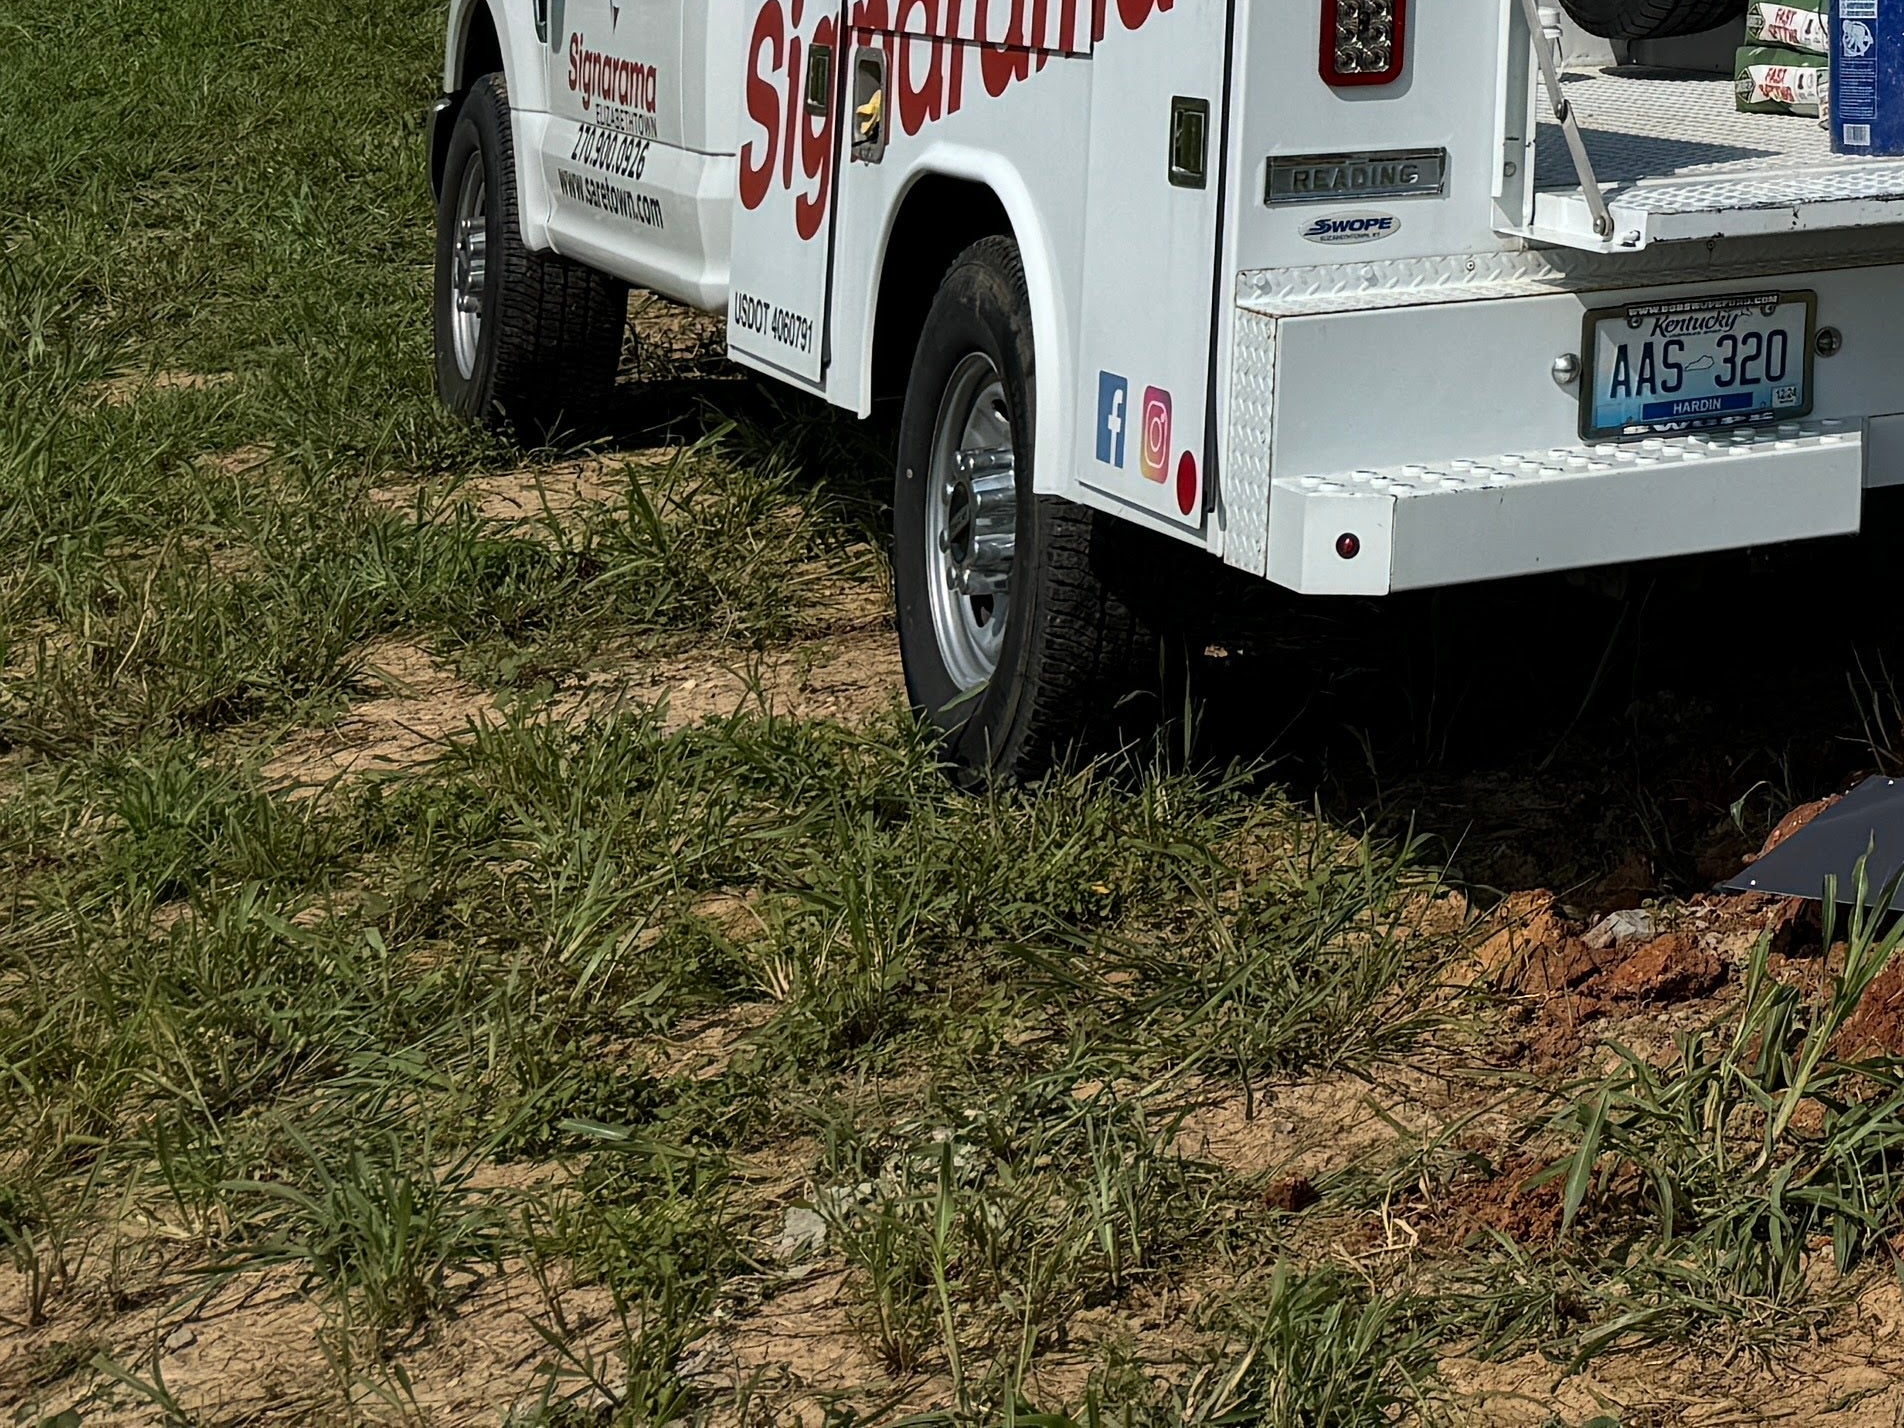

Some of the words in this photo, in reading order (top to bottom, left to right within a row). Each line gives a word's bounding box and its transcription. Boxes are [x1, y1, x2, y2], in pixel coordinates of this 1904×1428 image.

[1775, 8, 1797, 26] FAST
[568, 32, 657, 113] Signarama
[571, 123, 650, 181] 270.900.0926
[558, 168, 664, 229] www.saretown.com
[1292, 164, 1419, 192] READING
[1304, 217, 1394, 236] SWOPE
[735, 292, 770, 335] USDOT
[771, 307, 813, 354] 4060791
[1650, 311, 1739, 338] Kentucky
[1610, 339, 1685, 399] AAS
[1714, 330, 1788, 388] 320
[1673, 398, 1722, 415] HARDIN
